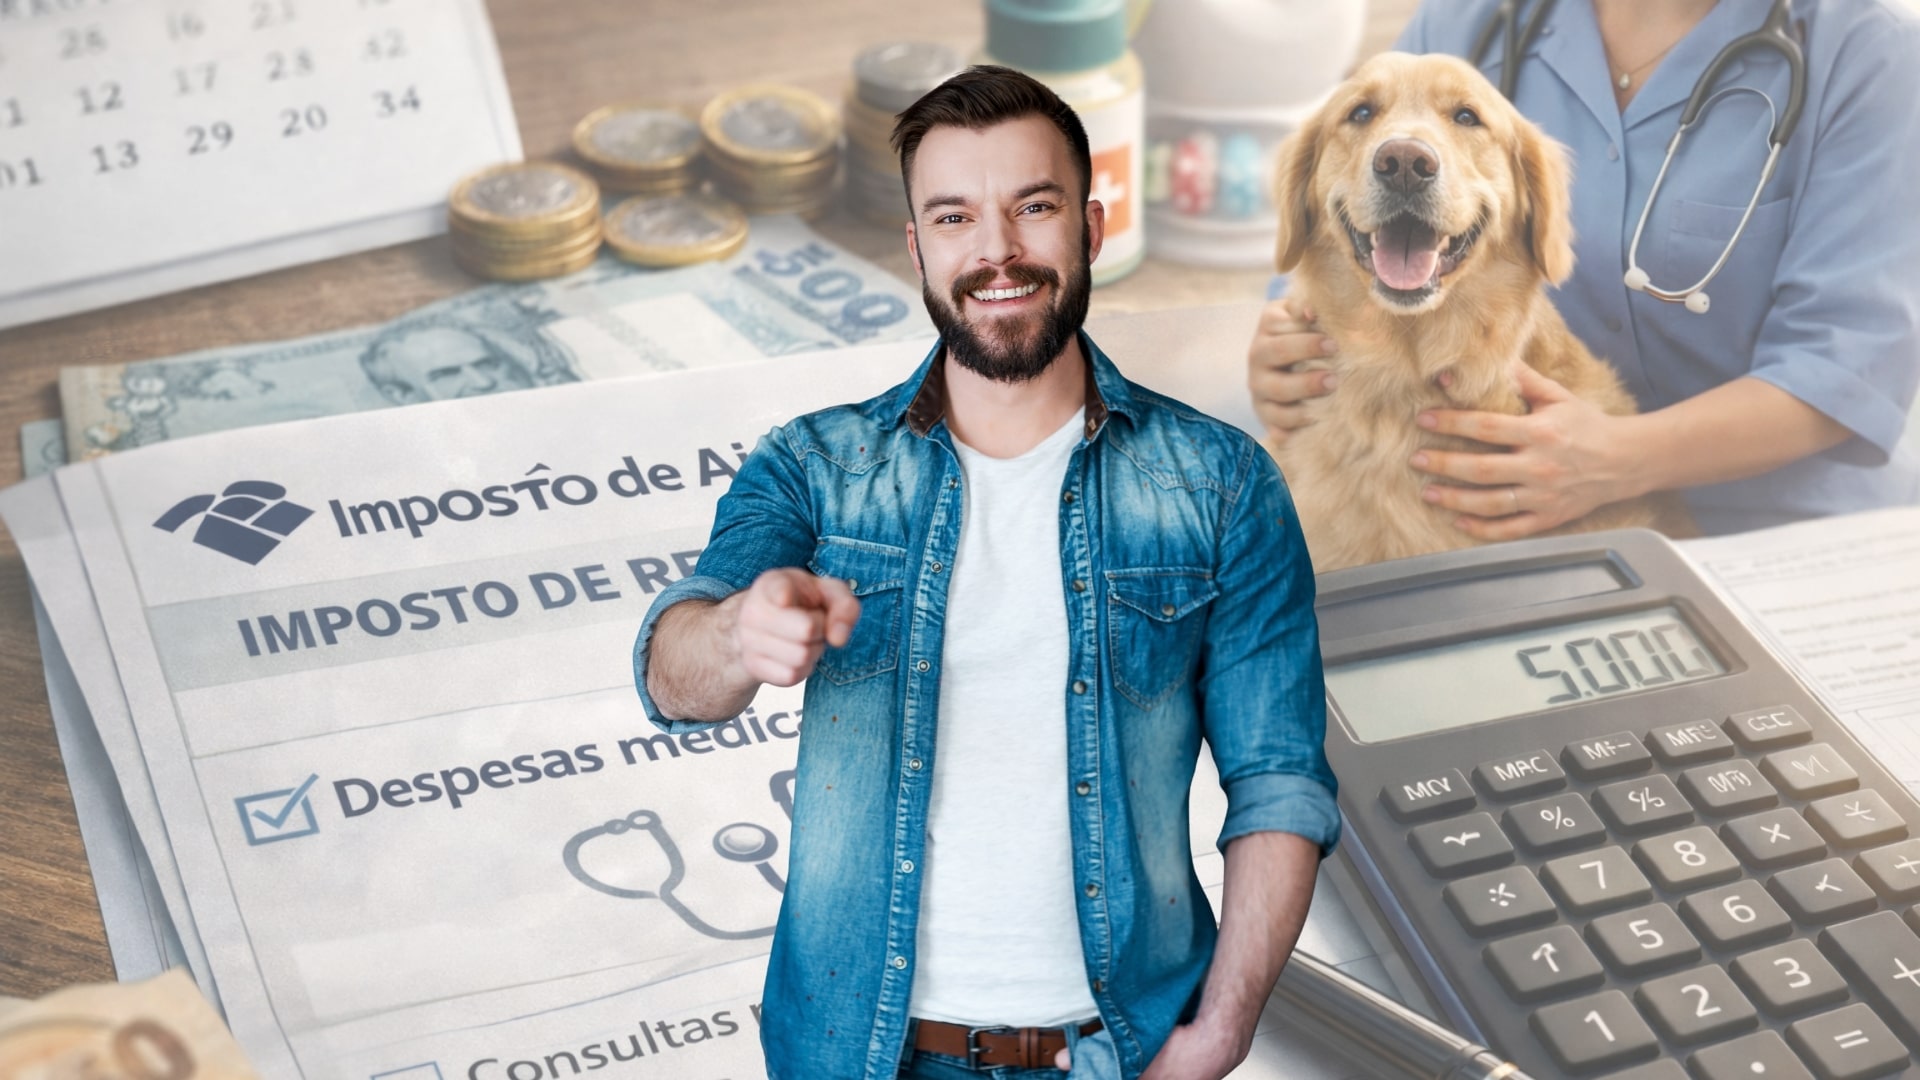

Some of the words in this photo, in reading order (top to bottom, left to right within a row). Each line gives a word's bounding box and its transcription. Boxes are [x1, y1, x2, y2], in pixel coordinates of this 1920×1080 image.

[76, 82, 124, 115] 12
[92, 140, 139, 174] 13
[186, 121, 234, 155] 29
[280, 104, 328, 138] 20
[372, 86, 421, 119] 34
[608, 456, 685, 498] de
[237, 581, 519, 657] IMPOSTO
[528, 564, 621, 610] DE
[333, 744, 604, 818] Despesas
[1673, 840, 1706, 866] 8
[1579, 860, 1606, 889] 7
[1722, 895, 1756, 923] 6
[1629, 919, 1663, 949] 5
[1773, 957, 1812, 988] 3
[1681, 983, 1721, 1017] 2
[1584, 1010, 1616, 1042] 1
[468, 1010, 739, 1080] Consultas
